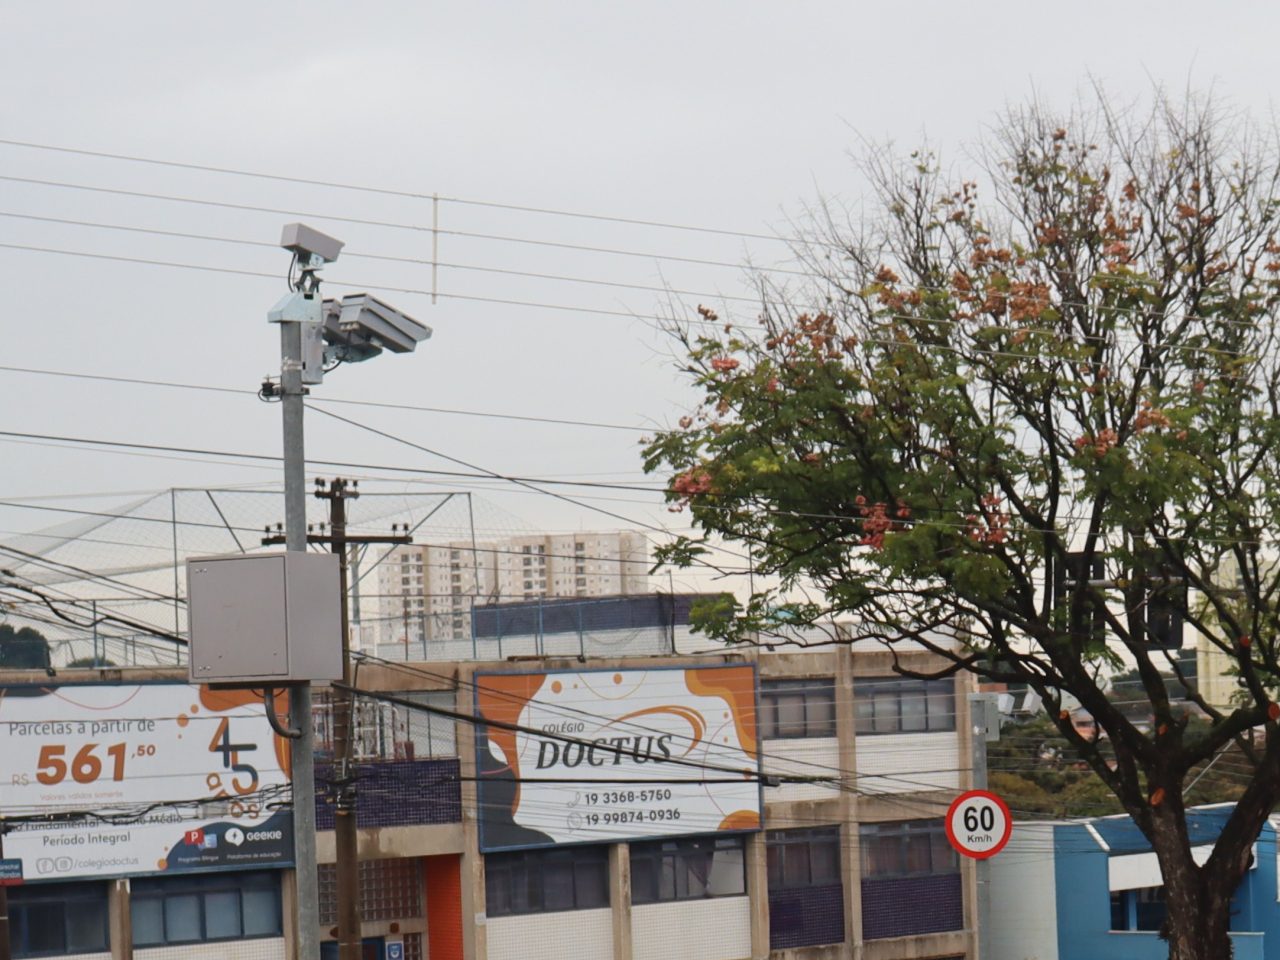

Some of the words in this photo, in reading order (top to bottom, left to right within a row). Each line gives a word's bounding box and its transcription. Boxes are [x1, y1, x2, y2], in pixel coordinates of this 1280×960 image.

[9, 721, 72, 736] Parcelas
[77, 723, 86, 734] a
[92, 719, 132, 736] partir
[137, 718, 156, 732] de
[542, 720, 585, 734] COLÉGIO
[535, 734, 673, 769] DOCTUS
[11, 773, 29, 787] R$
[585, 793, 599, 805] 19
[603, 788, 672, 804] 3368-5750
[585, 813, 599, 826] 19
[604, 808, 681, 825] 99874-0936
[963, 805, 995, 832] 60
[43, 833, 85, 847] Período
[88, 831, 131, 846] Integral
